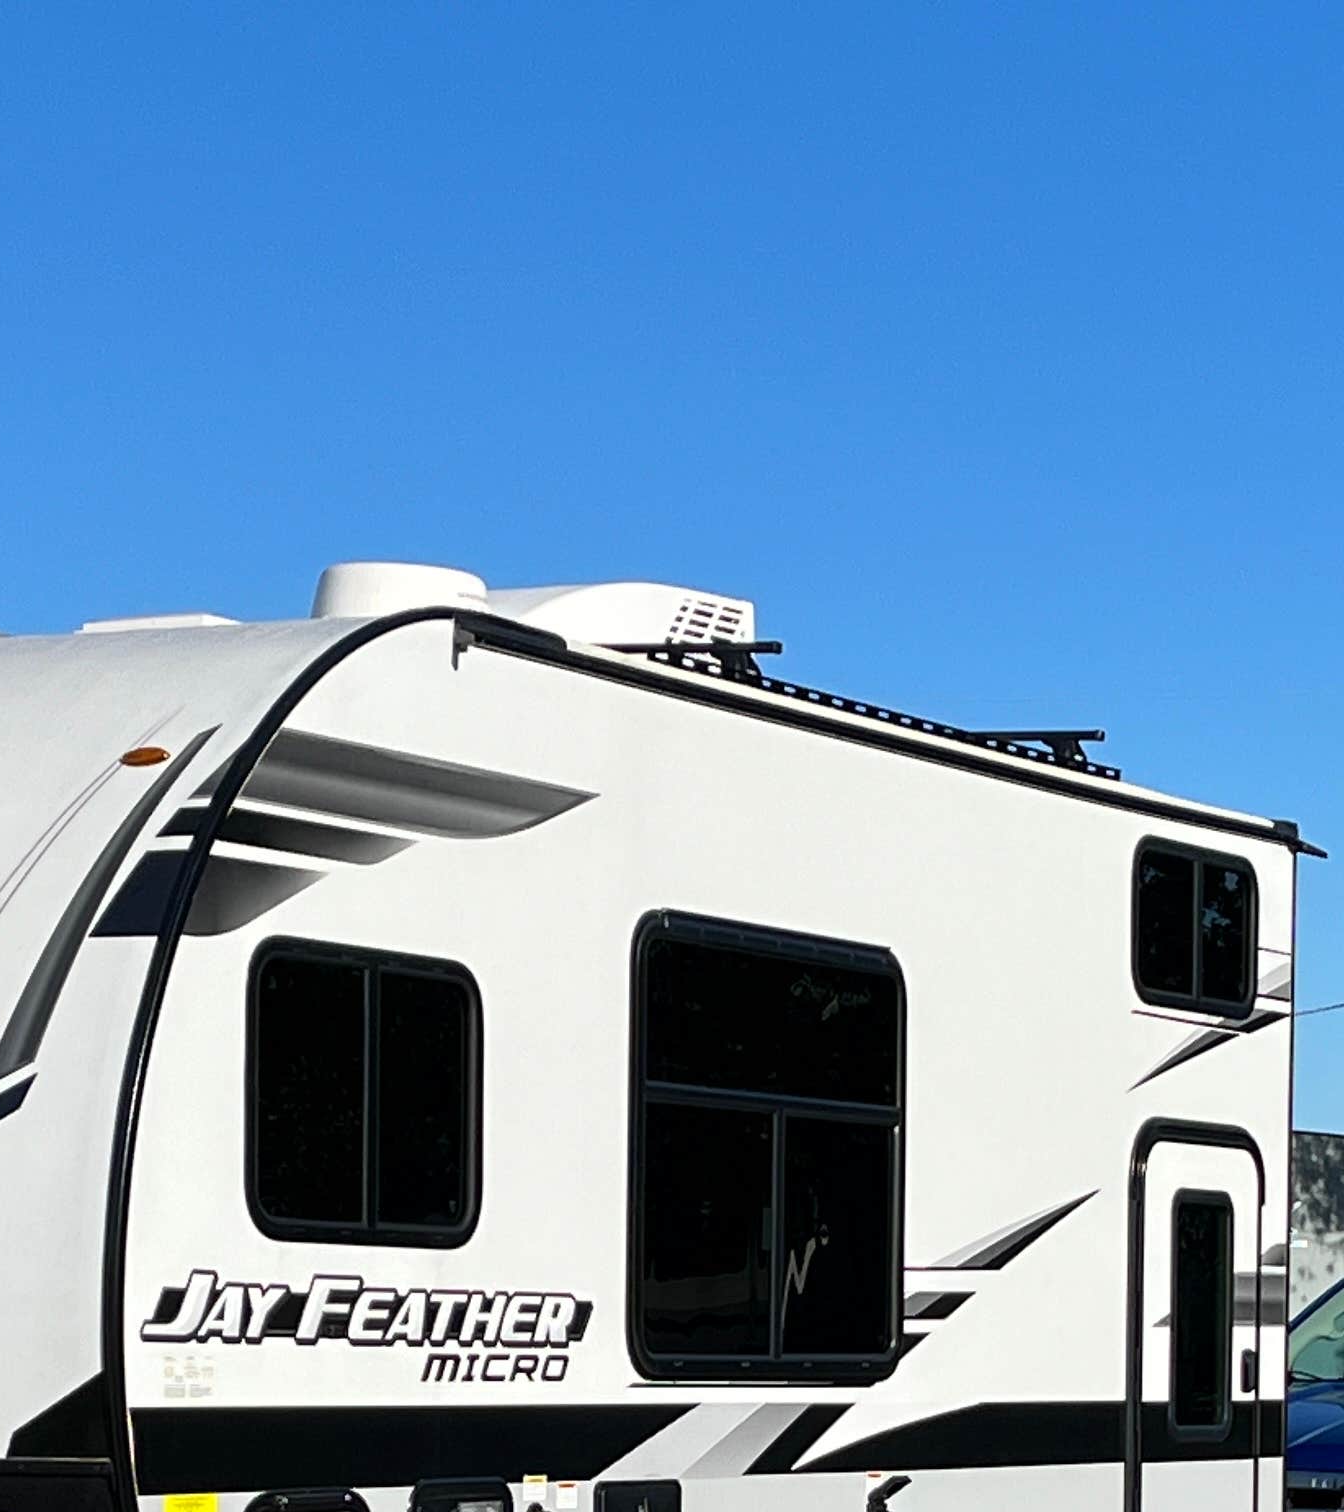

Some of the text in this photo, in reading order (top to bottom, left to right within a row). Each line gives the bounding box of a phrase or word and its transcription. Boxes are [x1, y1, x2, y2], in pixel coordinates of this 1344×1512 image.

[141, 1269, 579, 1349] JAY FEATHER
[421, 1353, 570, 1383] MICRO
